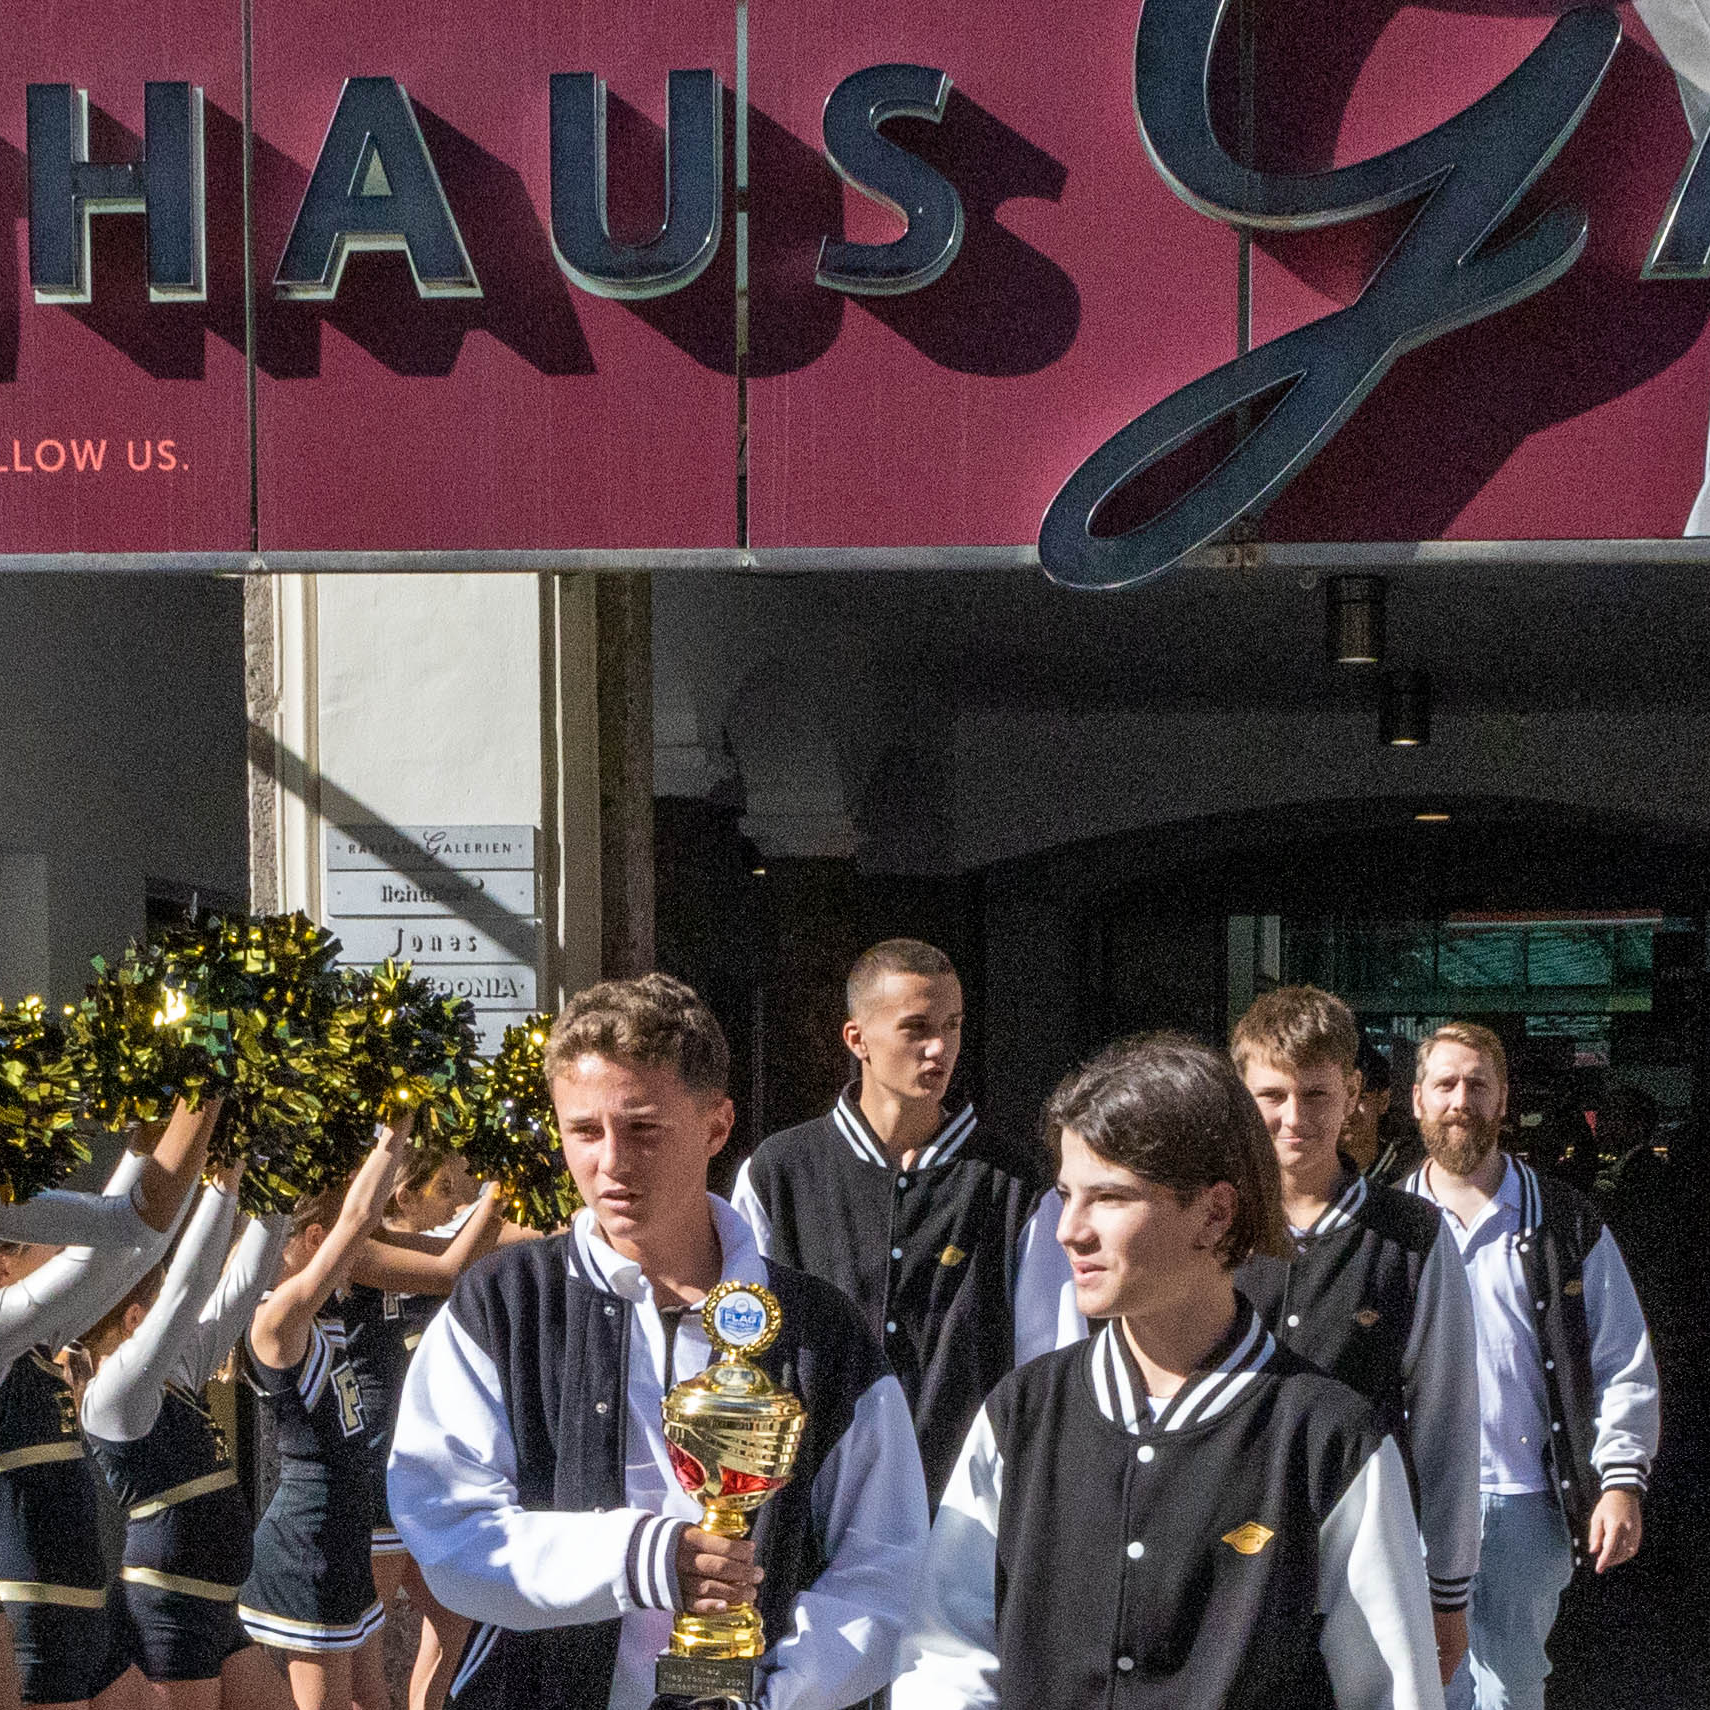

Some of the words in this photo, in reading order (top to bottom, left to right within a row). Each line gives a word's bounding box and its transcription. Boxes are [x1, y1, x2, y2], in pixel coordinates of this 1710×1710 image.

[126, 438, 189, 473] US.
[423, 831, 511, 862] GALERIEN
[388, 927, 478, 958] Jones
